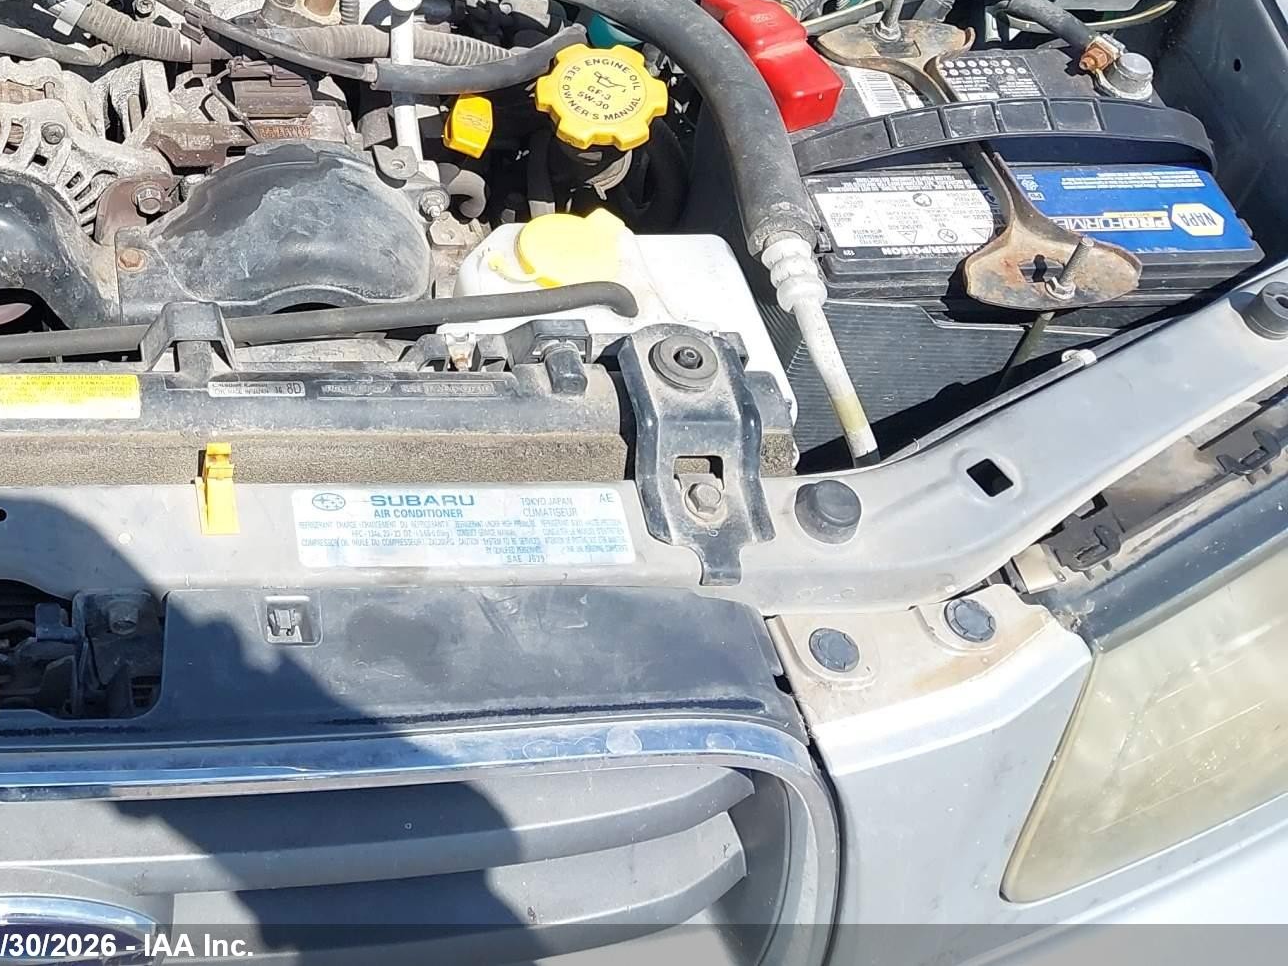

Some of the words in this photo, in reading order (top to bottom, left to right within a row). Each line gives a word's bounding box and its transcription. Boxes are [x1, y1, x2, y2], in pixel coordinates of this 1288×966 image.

[584, 58, 630, 74] ENGINE
[629, 74, 642, 91] OIL
[564, 65, 582, 84] SEE
[604, 96, 642, 121] MANUAL
[1179, 211, 1218, 228] NAPA
[369, 494, 475, 507] SUBARU
[549, 497, 573, 506] JAPAN
[599, 493, 615, 504] AE
[373, 509, 392, 518] AIR
[394, 508, 464, 518] CONDITIONER
[523, 507, 579, 518] CLIMATISEUR
